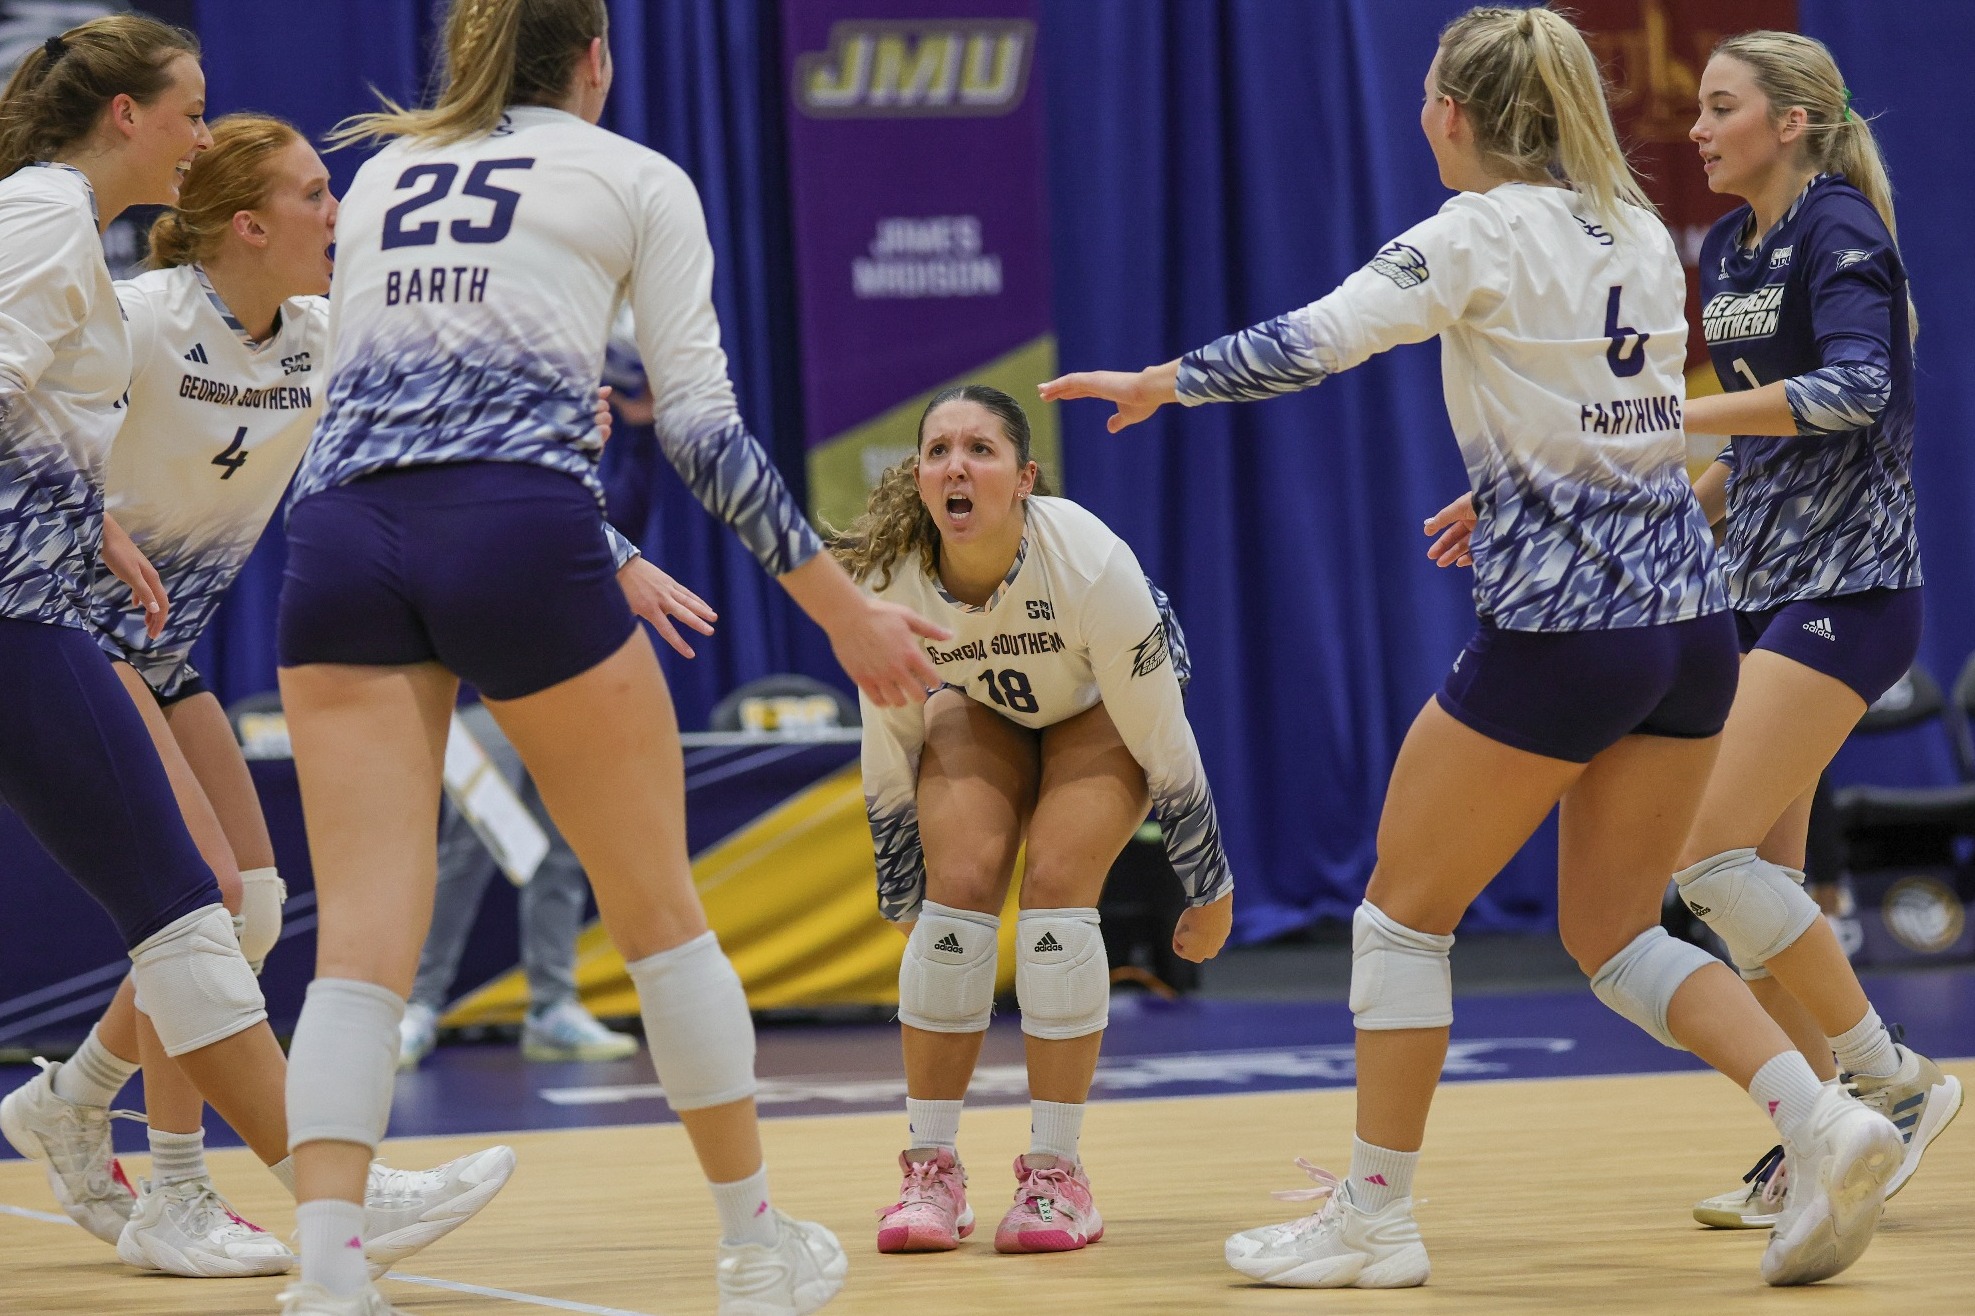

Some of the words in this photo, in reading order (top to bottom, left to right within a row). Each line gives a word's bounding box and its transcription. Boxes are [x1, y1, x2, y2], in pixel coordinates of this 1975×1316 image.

[803, 30, 1031, 108] JMU
[381, 157, 536, 251] 25
[386, 267, 489, 306] BARTH
[1703, 287, 1784, 318] GEORGIA
[1605, 285, 1650, 378] 6
[179, 374, 239, 406] GEORGIA
[237, 386, 312, 410] SOUTHERN
[1581, 394, 1682, 435] FARTHING
[211, 426, 249, 480] 4
[1802, 623, 1836, 642] adidas
[977, 668, 1039, 713] 18
[934, 943, 964, 954] adidas
[1034, 944, 1063, 953] adidas
